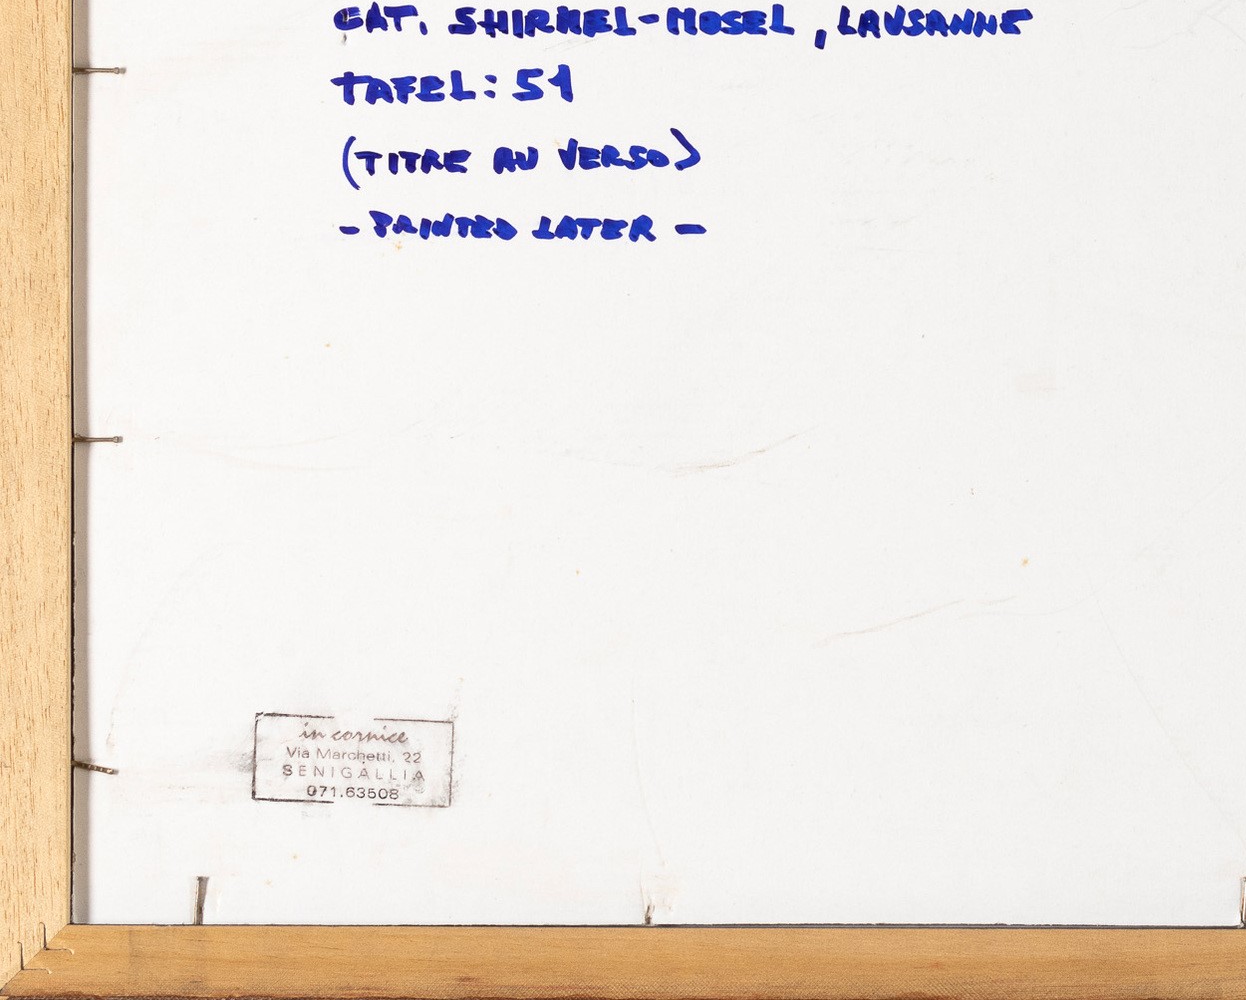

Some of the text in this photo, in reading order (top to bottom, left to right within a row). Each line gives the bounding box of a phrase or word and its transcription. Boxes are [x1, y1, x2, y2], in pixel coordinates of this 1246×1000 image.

[333, 2, 428, 36] CAT.
[331, 64, 574, 105] TAFEL: 51
[493, 147, 539, 174] AU
[532, 214, 657, 243] LATER
[299, 722, 409, 744] in cornice
[286, 746, 310, 760] Via
[403, 751, 422, 764] 22
[282, 764, 426, 782] SENIGALLIA
[306, 785, 400, 801] 071.63508
